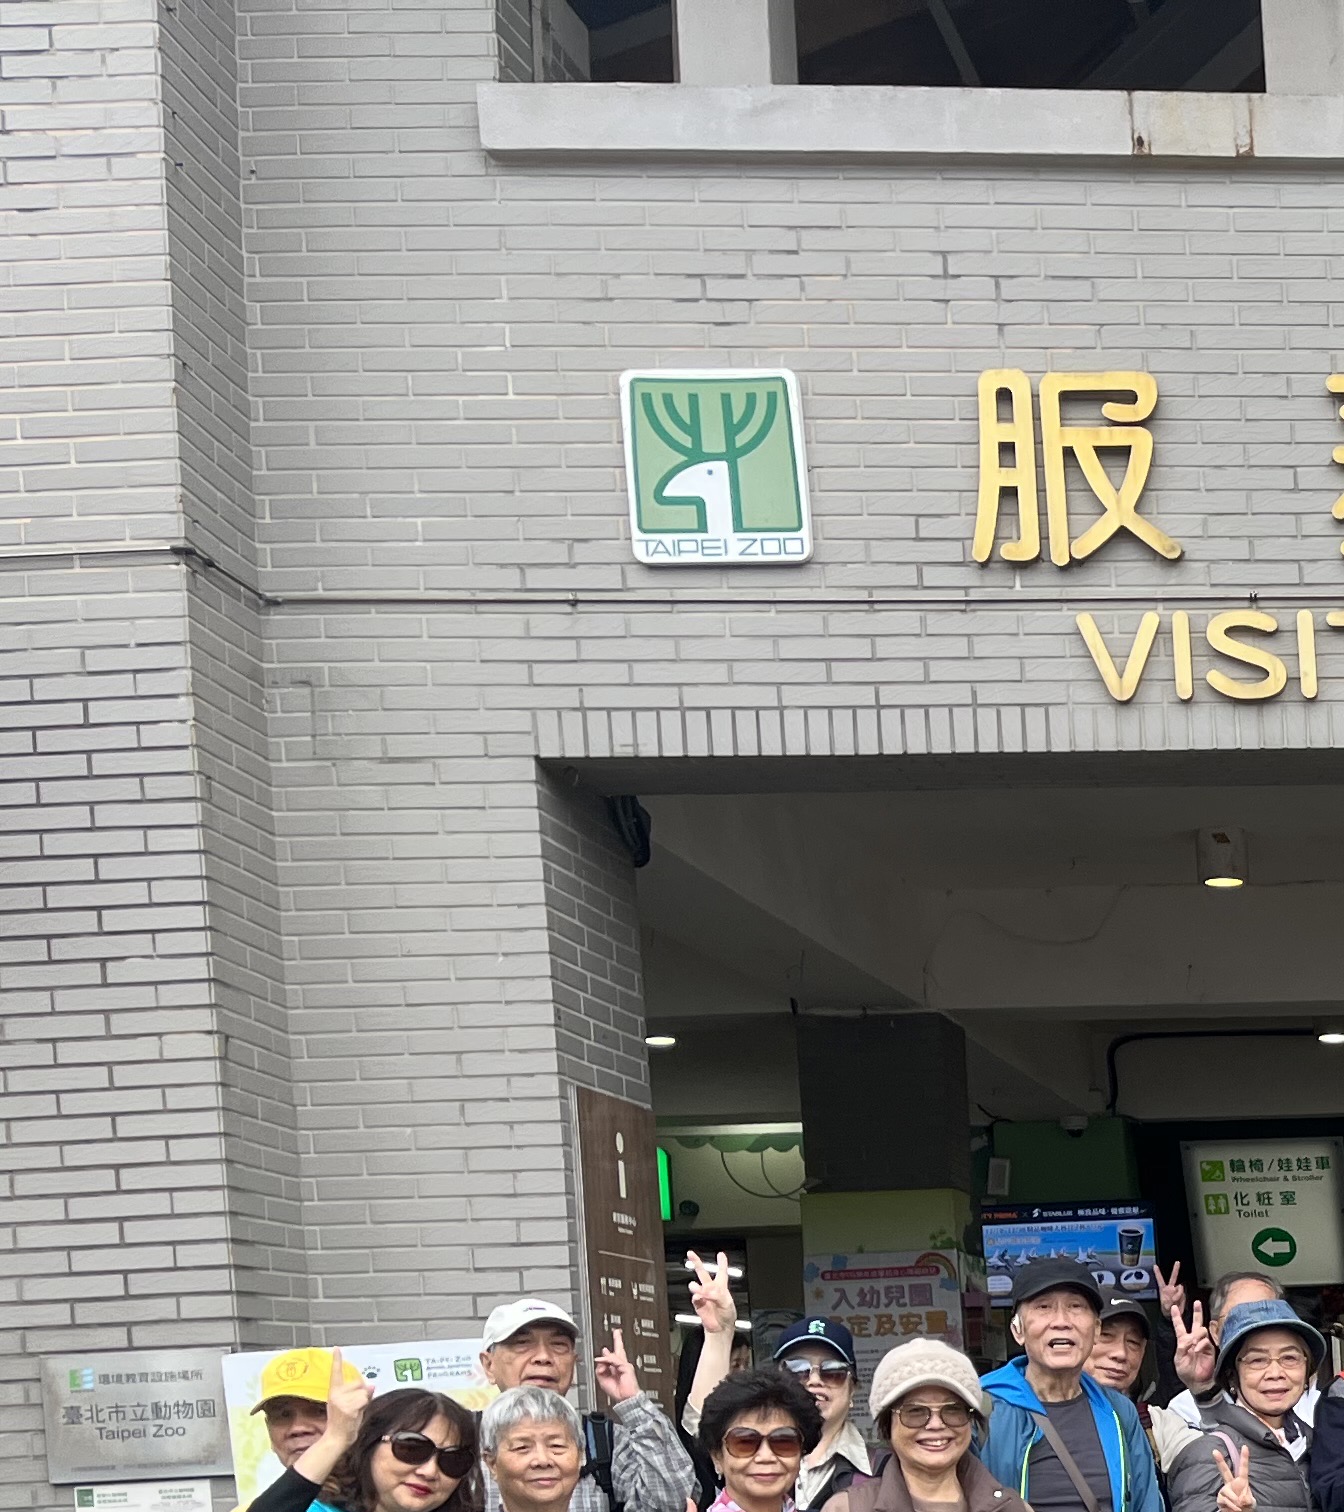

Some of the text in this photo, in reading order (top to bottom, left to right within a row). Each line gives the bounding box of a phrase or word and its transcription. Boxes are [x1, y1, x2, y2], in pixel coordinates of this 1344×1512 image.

[635, 538, 804, 557] TAIPEI ZOO
[1229, 1156, 1331, 1173] 輪椅/娃娃車
[1230, 1175, 1280, 1183] Wheelchair
[1292, 1174, 1323, 1182] Stroller
[1236, 1209, 1269, 1218] Toilet
[829, 1310, 949, 1338] 定及安置
[62, 1399, 216, 1426] 臺北市立動物園
[95, 1424, 186, 1442] Taipei Zoo
